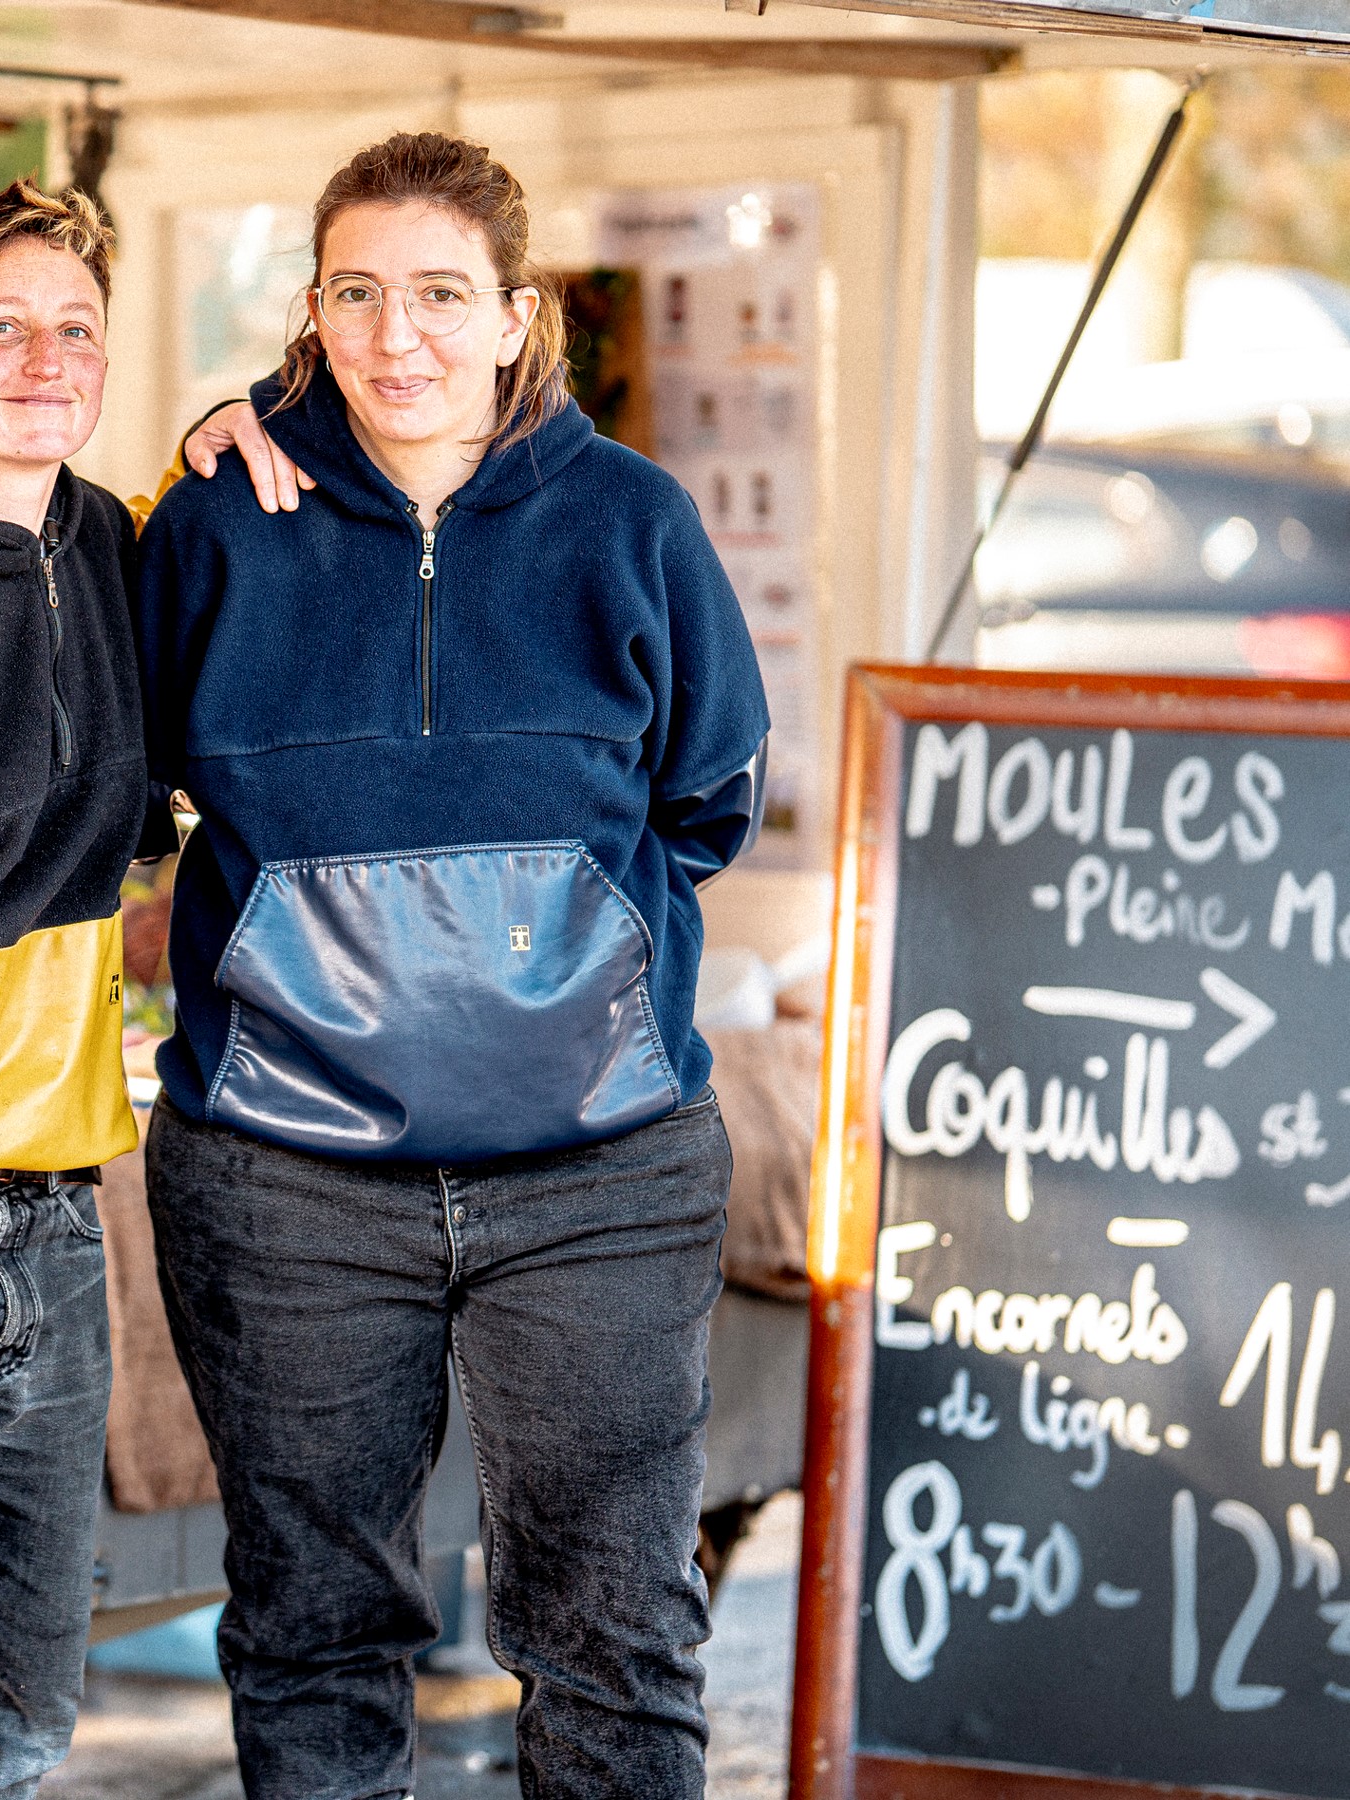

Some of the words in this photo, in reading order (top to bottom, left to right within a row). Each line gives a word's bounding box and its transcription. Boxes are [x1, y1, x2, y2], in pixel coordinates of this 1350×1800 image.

[1269, 869, 1350, 966] M
[882, 1008, 1242, 1223] Coquilles
[876, 1220, 1189, 1365] Encornets
[1218, 1281, 1350, 1496] 14
[874, 1459, 1084, 1683] 8h30
